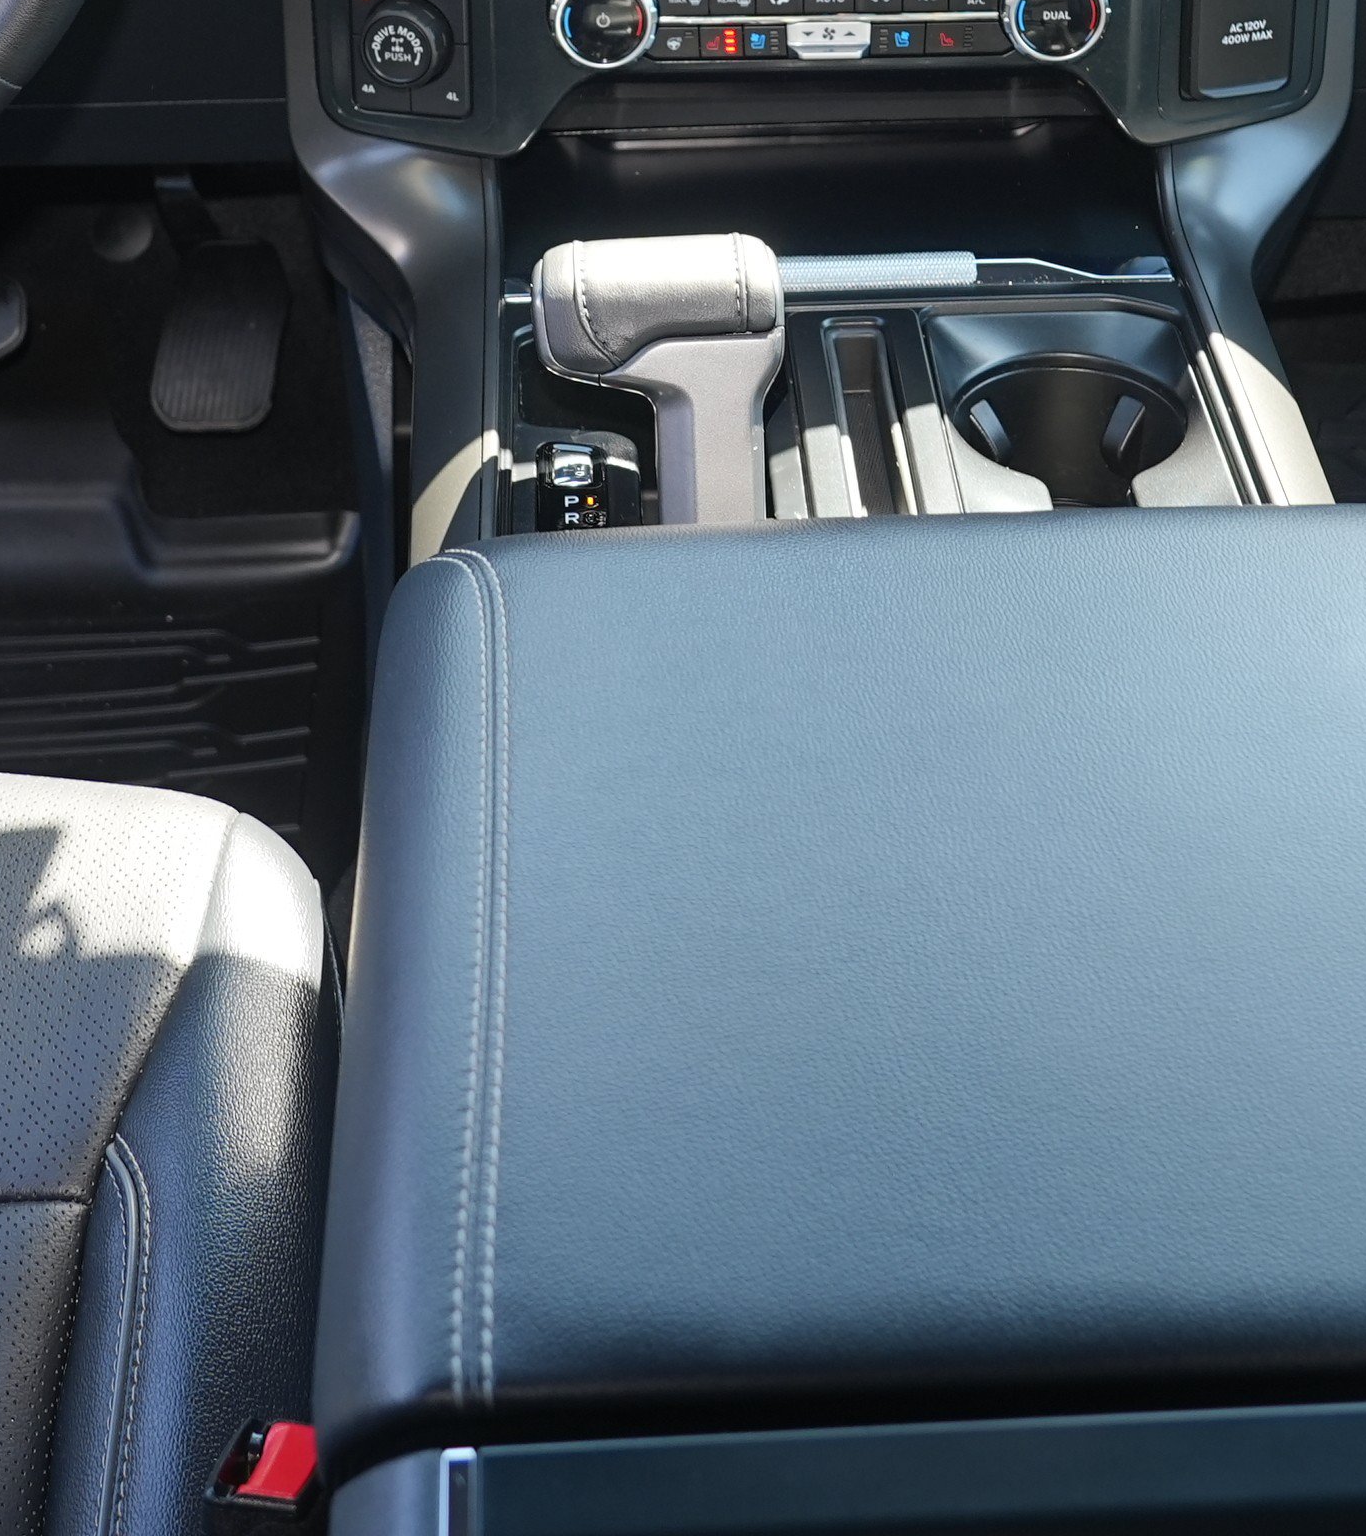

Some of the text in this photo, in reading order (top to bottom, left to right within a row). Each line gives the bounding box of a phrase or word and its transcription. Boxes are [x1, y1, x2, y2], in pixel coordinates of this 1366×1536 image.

[1042, 11, 1071, 20] DUAL
[1229, 19, 1267, 33] AC 120V
[371, 25, 424, 54] DRIVE MODE
[1222, 29, 1273, 45] 400W MAX
[384, 52, 412, 62] PUSH
[361, 84, 376, 93] 4A
[446, 91, 460, 101] 4L
[564, 495, 580, 508] P
[564, 512, 580, 525] R
